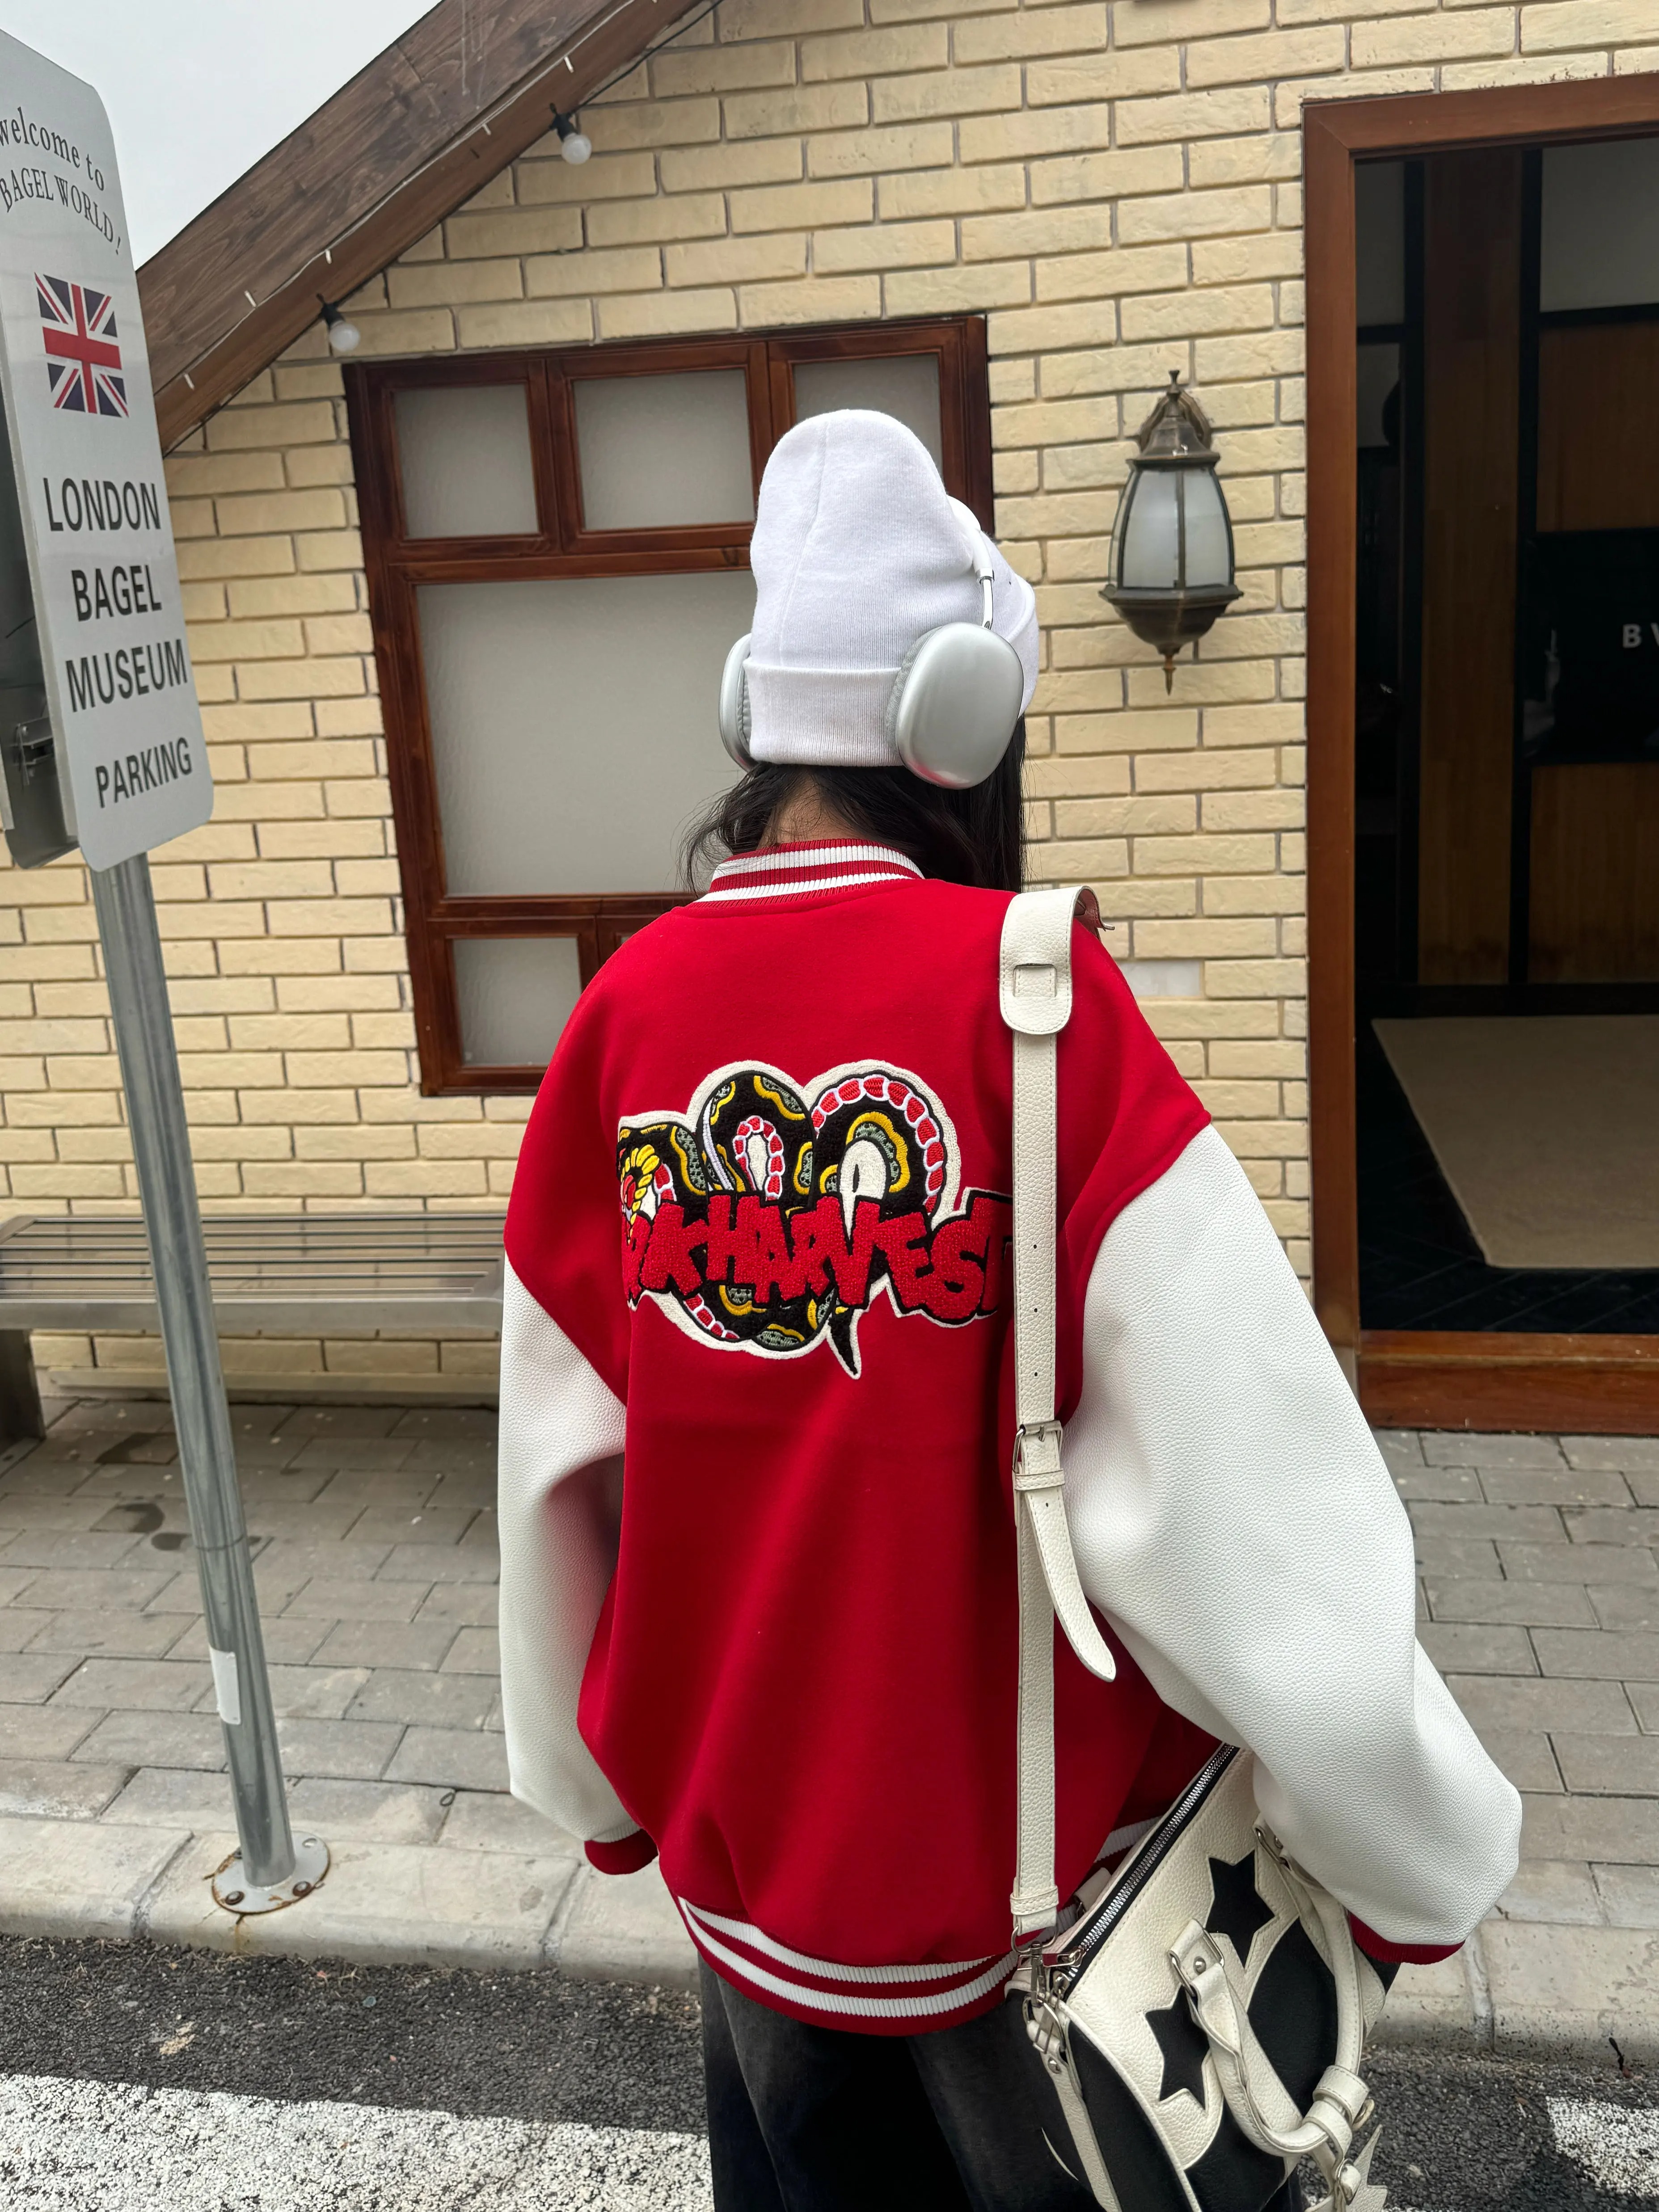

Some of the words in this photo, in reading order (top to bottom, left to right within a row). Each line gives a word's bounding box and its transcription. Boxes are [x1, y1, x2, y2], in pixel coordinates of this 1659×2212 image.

[0, 106, 80, 168] welcome
[86, 154, 104, 191] to
[0, 168, 54, 213] BAGEL
[43, 477, 161, 532] LONDON
[71, 564, 162, 622] BAGEL
[66, 639, 188, 713] MUSEUM
[95, 737, 193, 808] PARKING
